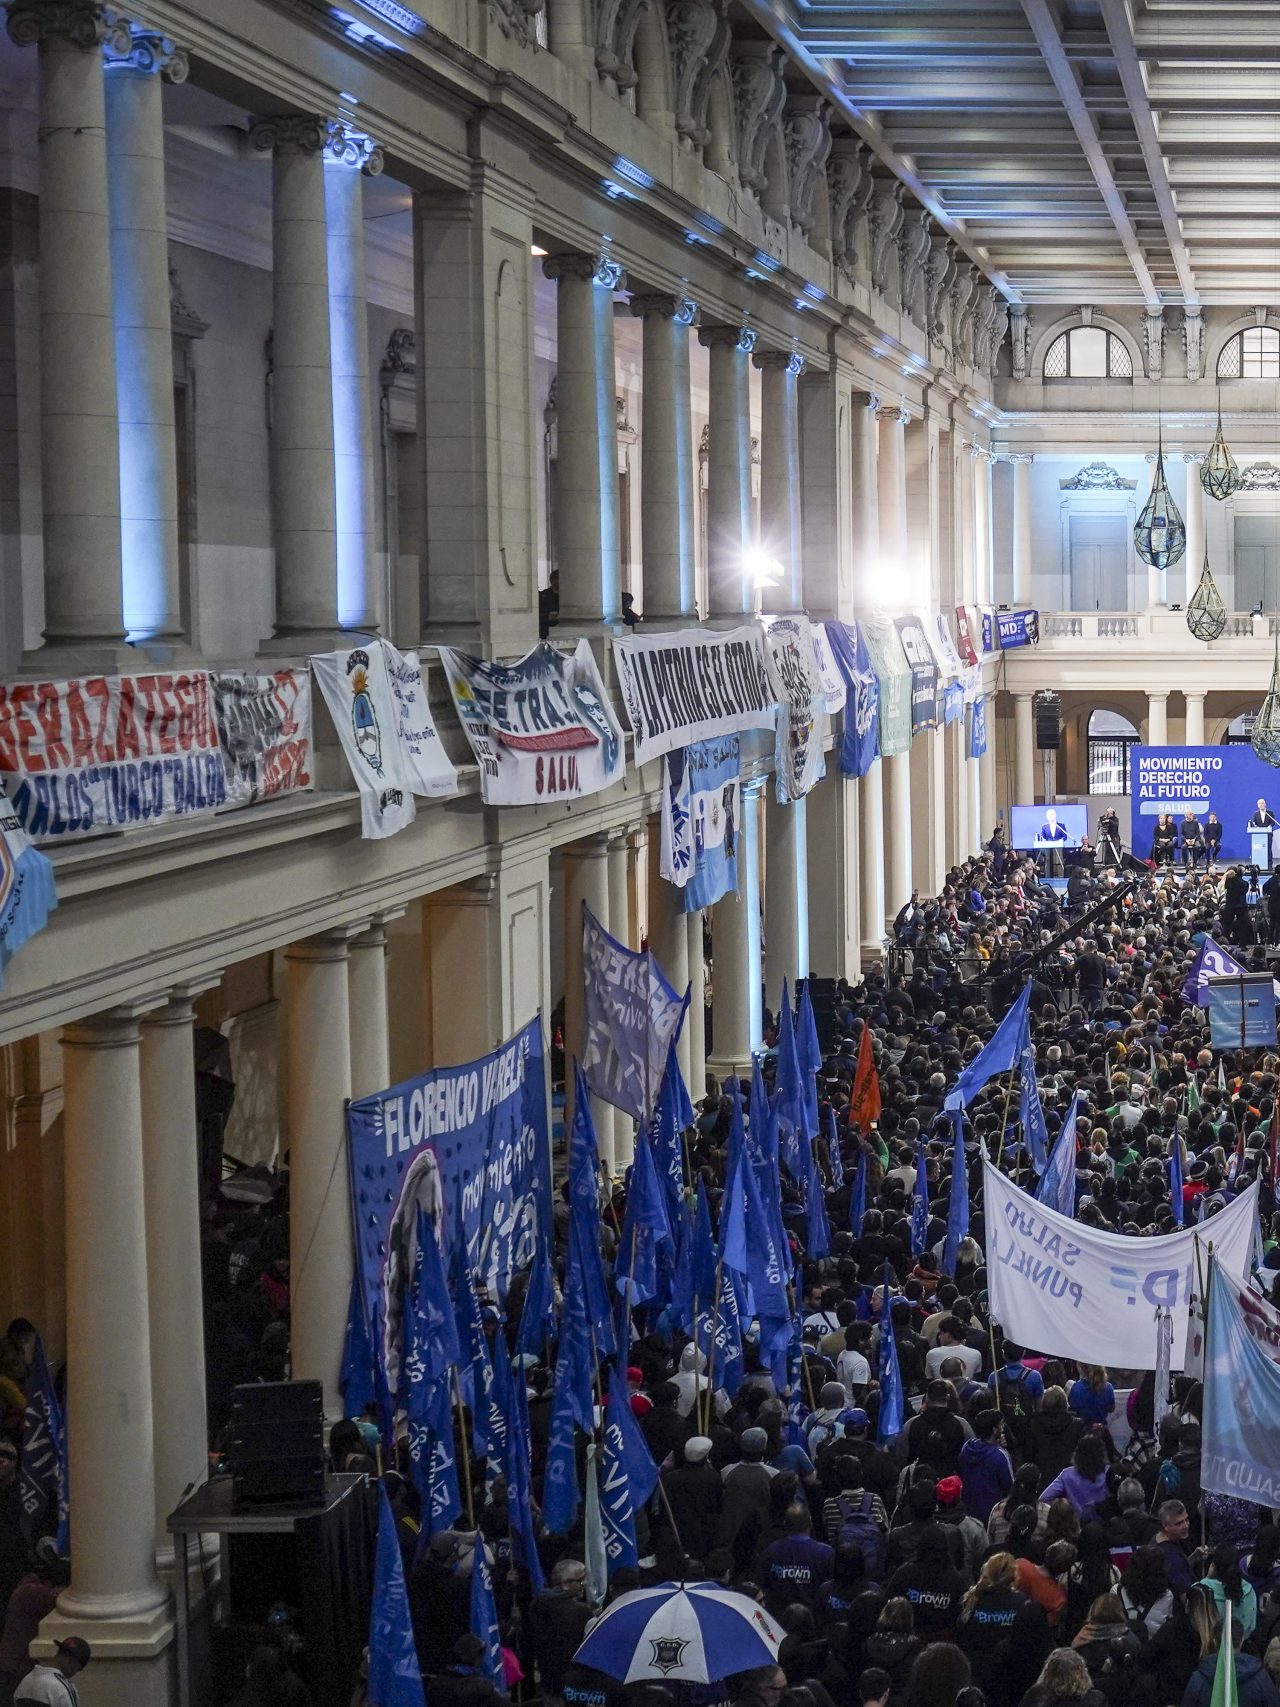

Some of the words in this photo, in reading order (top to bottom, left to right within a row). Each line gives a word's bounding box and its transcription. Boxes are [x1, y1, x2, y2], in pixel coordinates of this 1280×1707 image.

[630, 652, 664, 739] LA
[649, 645, 709, 731] PATRIA
[695, 644, 723, 719] ES
[711, 645, 737, 716] EL
[725, 640, 763, 715] OTRO
[1139, 757, 1223, 770] MOVIMIENTO
[536, 755, 582, 796] SALU
[1139, 772, 1203, 784] DERECHO
[1139, 785, 1156, 797] AL
[1158, 785, 1211, 798] FUTURO
[384, 1070, 479, 1158] FLORENCIO
[482, 1037, 527, 1116] VARELA
[461, 1125, 536, 1222] movimiento
[773, 1564, 811, 1580] Brown
[908, 1588, 951, 1606] Brown
[564, 1687, 606, 1703] Brown
